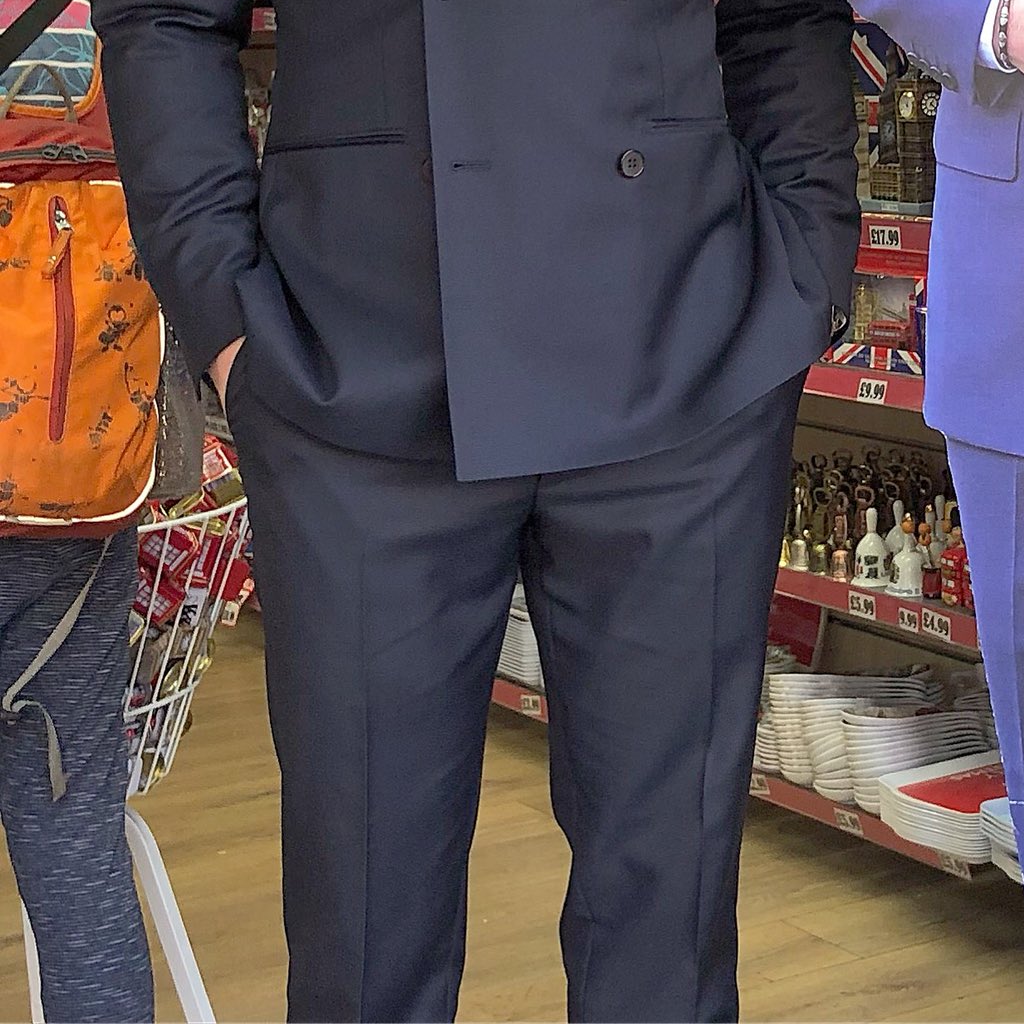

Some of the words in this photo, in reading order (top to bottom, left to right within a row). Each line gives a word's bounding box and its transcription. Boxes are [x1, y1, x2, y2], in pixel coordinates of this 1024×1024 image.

[871, 228, 899, 246] £17.99
[859, 382, 885, 400] £9.99
[850, 595, 874, 616] £5.99
[923, 612, 949, 636] £4.99
